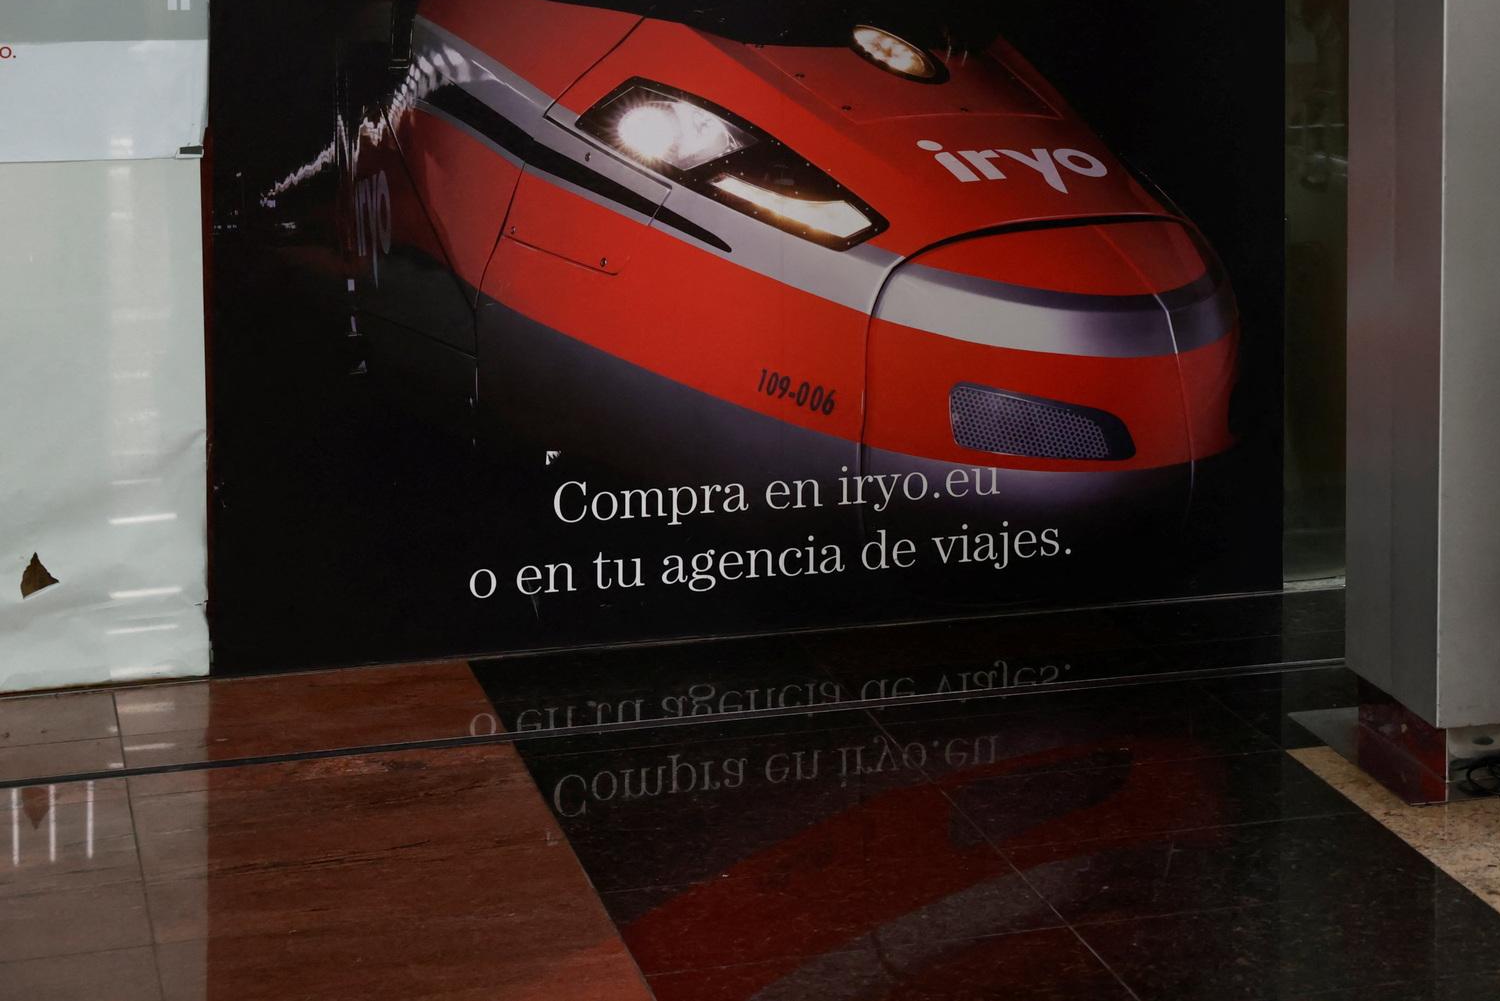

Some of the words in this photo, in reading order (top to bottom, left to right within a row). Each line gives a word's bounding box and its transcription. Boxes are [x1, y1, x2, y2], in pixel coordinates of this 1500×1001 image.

[916, 139, 1108, 194] iryo
[758, 368, 837, 416] 109-006
[553, 480, 749, 526] Compra
[765, 479, 823, 510] en
[837, 465, 1001, 511] iryo.eu
[469, 568, 497, 599] o
[516, 562, 577, 595] en
[592, 551, 646, 590] tu
[661, 535, 846, 591] agencia
[861, 529, 916, 570] de
[931, 520, 1072, 570] viajes.
